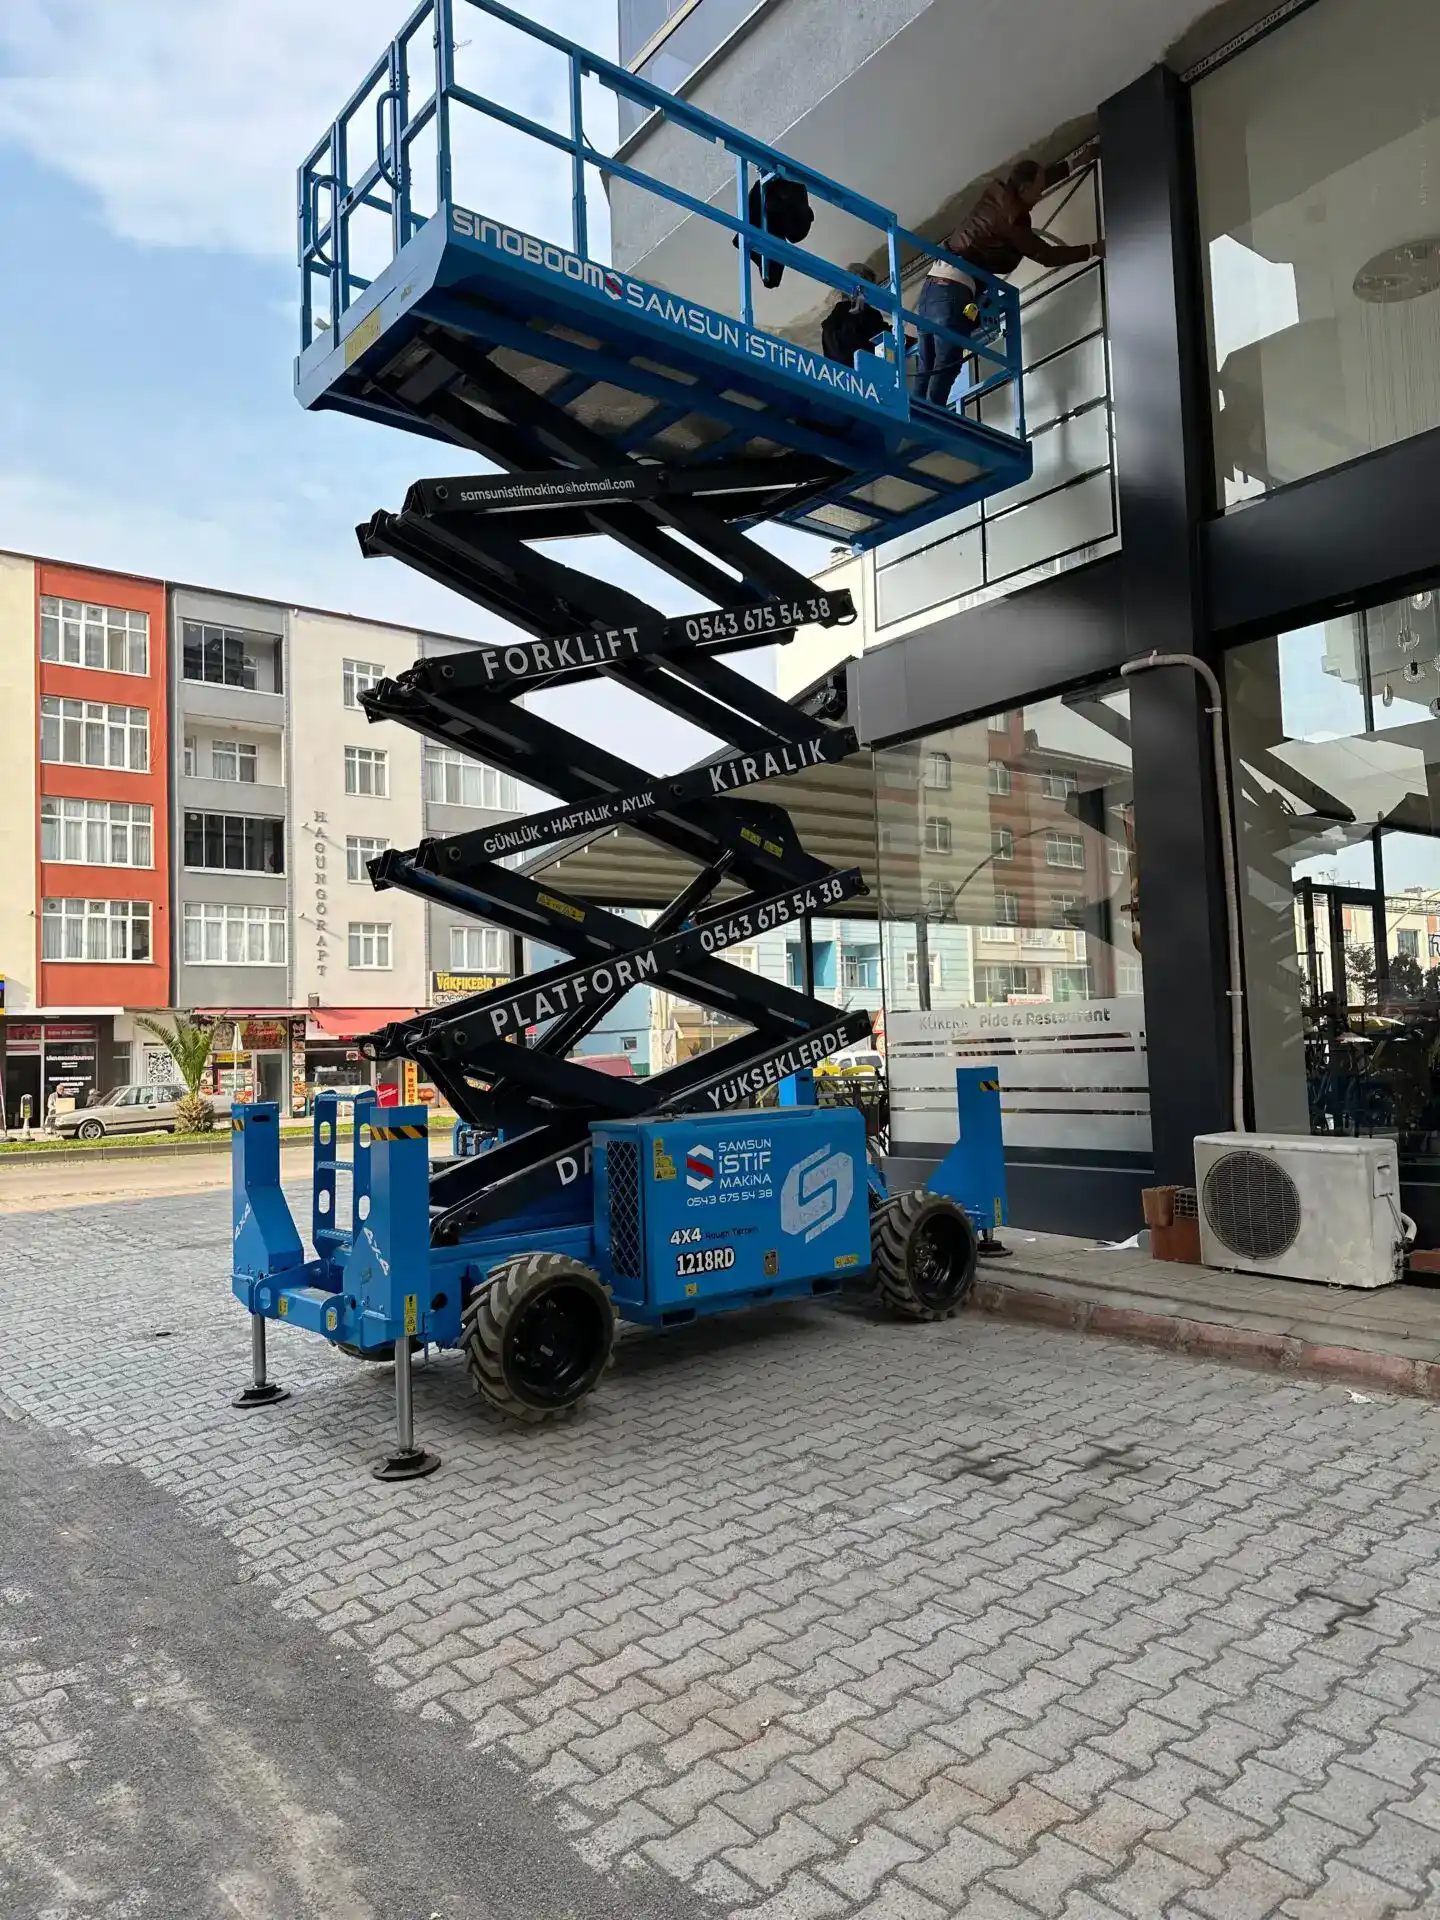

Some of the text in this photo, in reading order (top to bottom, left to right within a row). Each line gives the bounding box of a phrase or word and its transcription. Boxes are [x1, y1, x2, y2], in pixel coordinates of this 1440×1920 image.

[626, 283, 741, 350] SAMSUN
[459, 476, 636, 502] samsunistifmakina@hotmail.com
[685, 597, 832, 642] 0543 675 54 38
[482, 791, 656, 854] GÜNLÜK HAFTALIK AYLIK
[699, 878, 844, 952] 0543 675 54 38
[488, 949, 659, 1037] PLATFORM
[979, 1012, 1009, 1028] Pide
[1026, 1007, 1111, 1027] Restaurant
[707, 1026, 850, 1111] YÜKSEKLERDE
[718, 1138, 772, 1153] SAMSUN
[686, 1188, 773, 1208] 0543 675 54 38
[670, 1227, 702, 1246] 4X4
[676, 1247, 736, 1278] 1218RD
